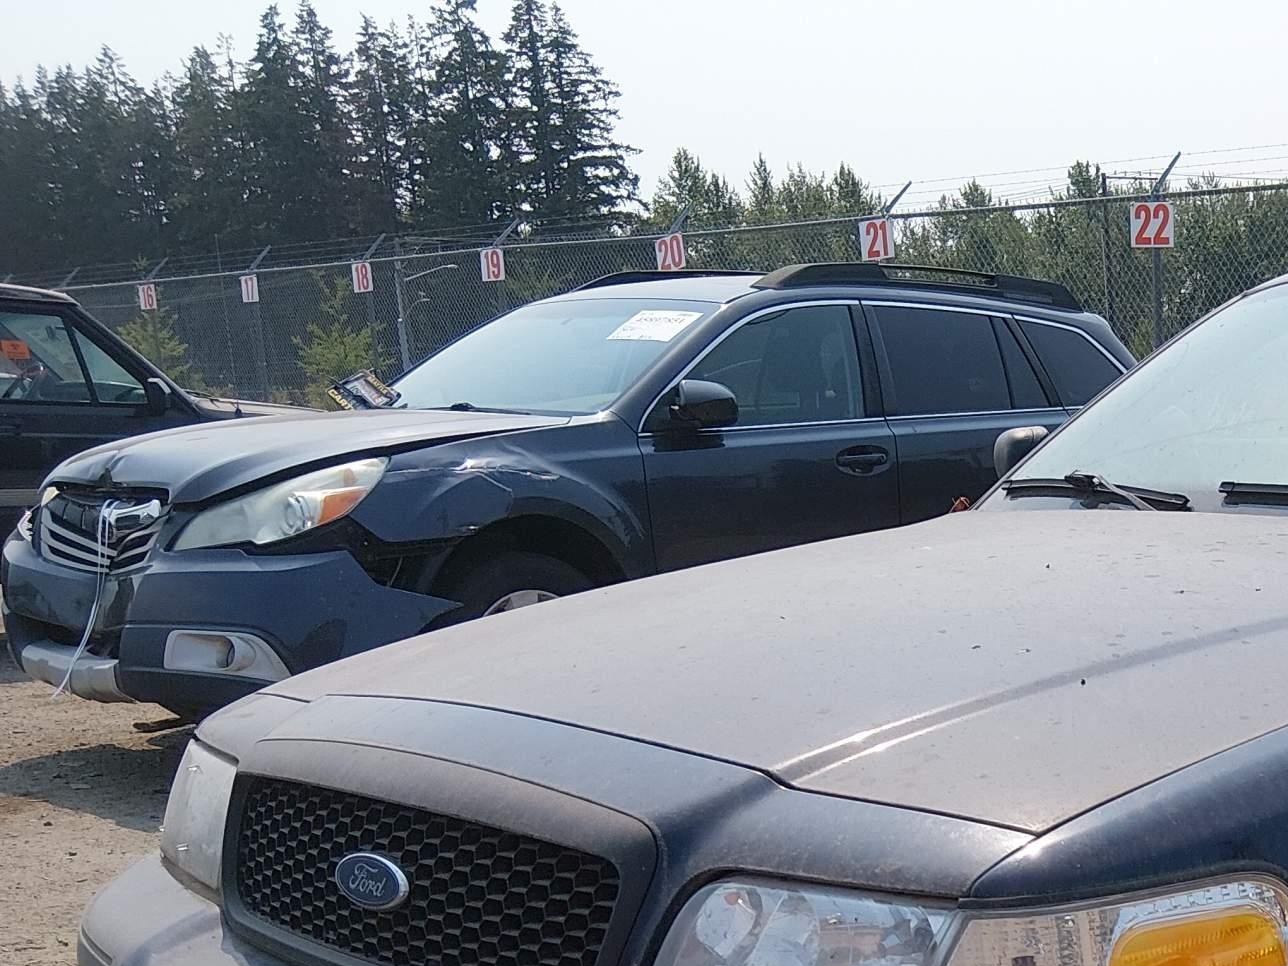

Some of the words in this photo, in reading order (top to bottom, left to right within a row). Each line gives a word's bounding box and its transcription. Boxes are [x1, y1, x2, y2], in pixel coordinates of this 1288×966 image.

[865, 220, 889, 259] 21
[1133, 203, 1171, 246] 22
[484, 249, 502, 280] 19
[658, 235, 684, 271] 20
[243, 276, 255, 301] 17
[355, 263, 370, 291] 18
[141, 285, 155, 309] 16
[349, 863, 387, 897] Ford
